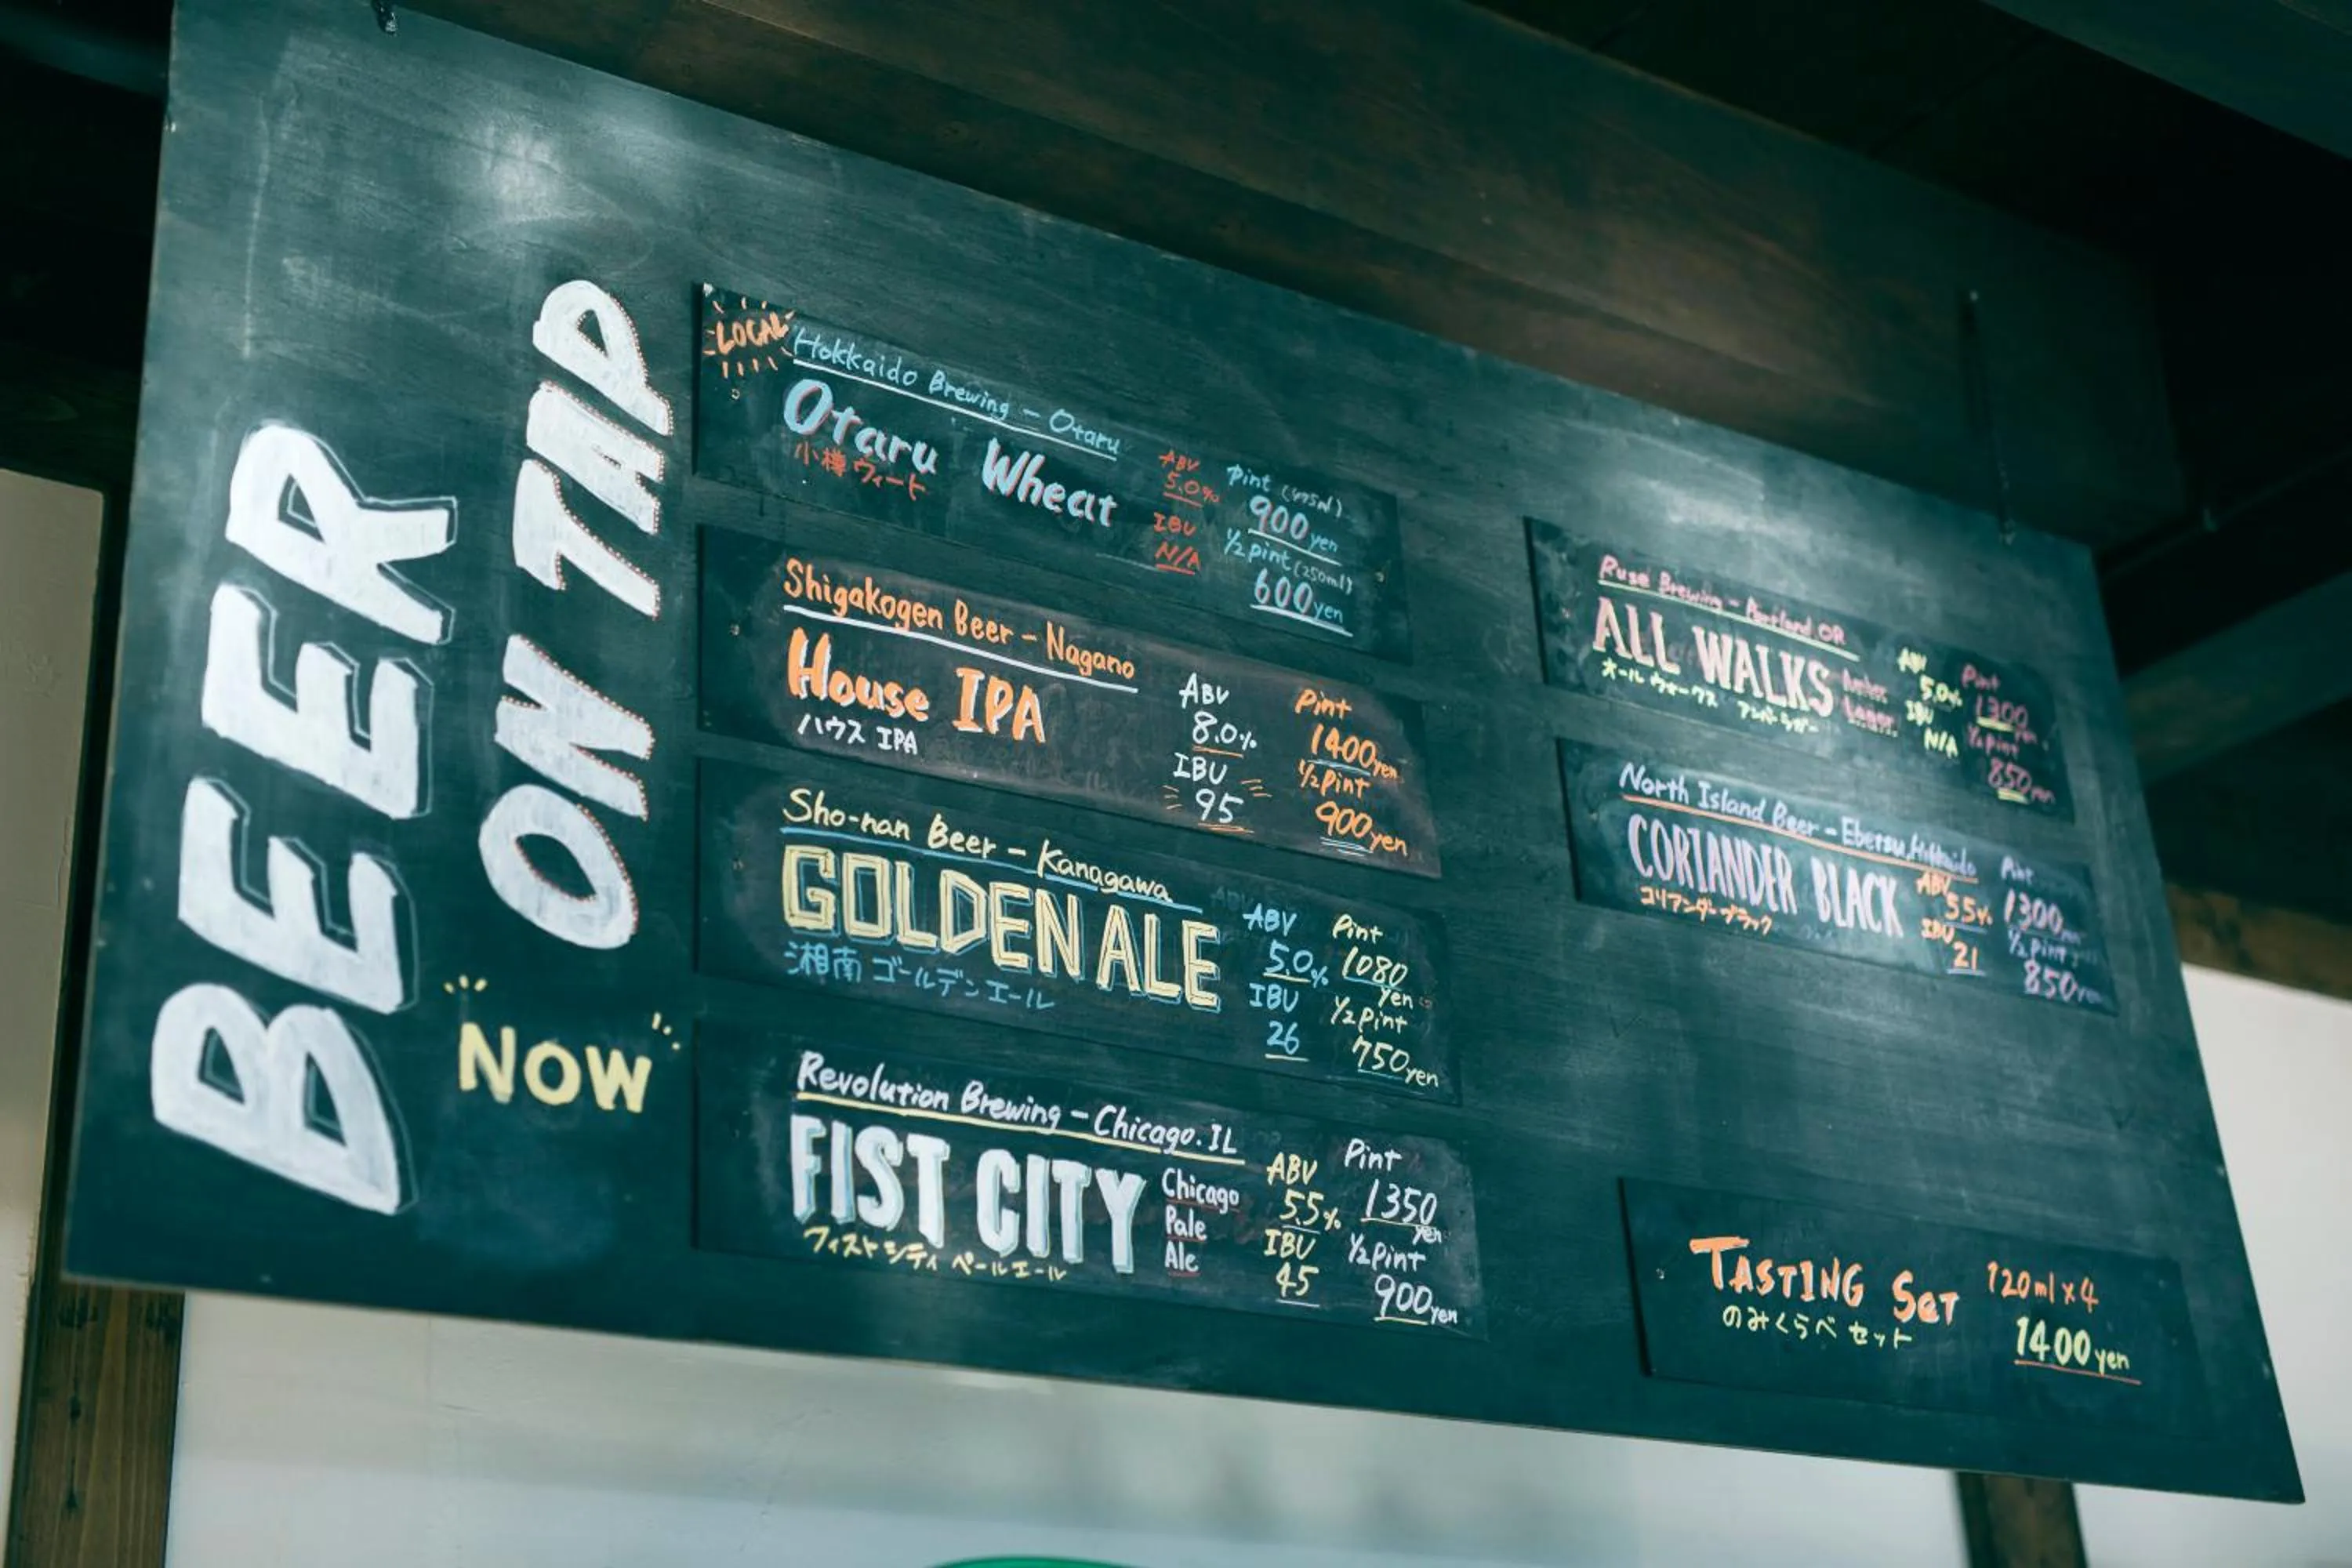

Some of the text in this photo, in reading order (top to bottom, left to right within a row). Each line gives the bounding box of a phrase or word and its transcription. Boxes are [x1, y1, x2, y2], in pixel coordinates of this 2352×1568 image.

[716, 312, 789, 354] LOCAL
[793, 327, 917, 386] Hokkaido
[930, 370, 1010, 420] Brewing
[1050, 408, 1120, 454] Otaru
[784, 379, 1118, 527] Otaru Wheat
[1159, 449, 1200, 472] ABV
[1154, 512, 1197, 537] IBU
[1155, 542, 1202, 571] N/A
[480, 279, 673, 949] ON TAP
[784, 558, 942, 631] Shigakogen
[954, 598, 1014, 644] Beer
[1046, 620, 1135, 679] Nagano
[1593, 596, 1833, 717] ALL WALKS
[787, 627, 1045, 744] House IPA
[1178, 673, 1229, 709] ABV
[1294, 688, 1352, 719] Pint
[797, 714, 918, 756] ハウス IPA
[1192, 710, 1258, 750] 8.0%
[1173, 752, 1229, 785] IBU
[152, 420, 457, 1214] BEER
[1195, 788, 1244, 824] 95
[1619, 761, 1690, 804] North
[1697, 780, 1766, 822] Island
[1773, 800, 1819, 836] Beer
[783, 787, 910, 841] Sho-nan
[927, 813, 996, 858] Beer
[1036, 839, 1174, 902] Kanagawa
[1628, 813, 1904, 938] CORIANDER BLACK
[782, 844, 1221, 1013] GOLDEN ALE
[1243, 903, 1298, 937] ABV
[1333, 913, 1384, 943] Pint
[1342, 946, 1409, 988] 1080
[1953, 941, 1978, 972] 21
[1249, 982, 1299, 1013] IBU
[1377, 986, 1413, 1009] yen
[1266, 1021, 1300, 1054] 26
[458, 1022, 652, 1113] NOW
[797, 1051, 949, 1112] Revolution
[960, 1080, 1062, 1134] Brewing
[1267, 1152, 1317, 1185] ABV
[1345, 1138, 1403, 1171] Pint
[790, 1113, 1147, 1275] FIST CITY
[1162, 1167, 1240, 1214] Chicago
[1364, 1179, 1438, 1226] 1350
[1165, 1206, 1207, 1240] Pale
[1165, 1241, 1200, 1273] Ale
[1264, 1229, 1316, 1259] IBU
[1276, 1262, 1320, 1299] 45
[1690, 1236, 1864, 1307] TASTING
